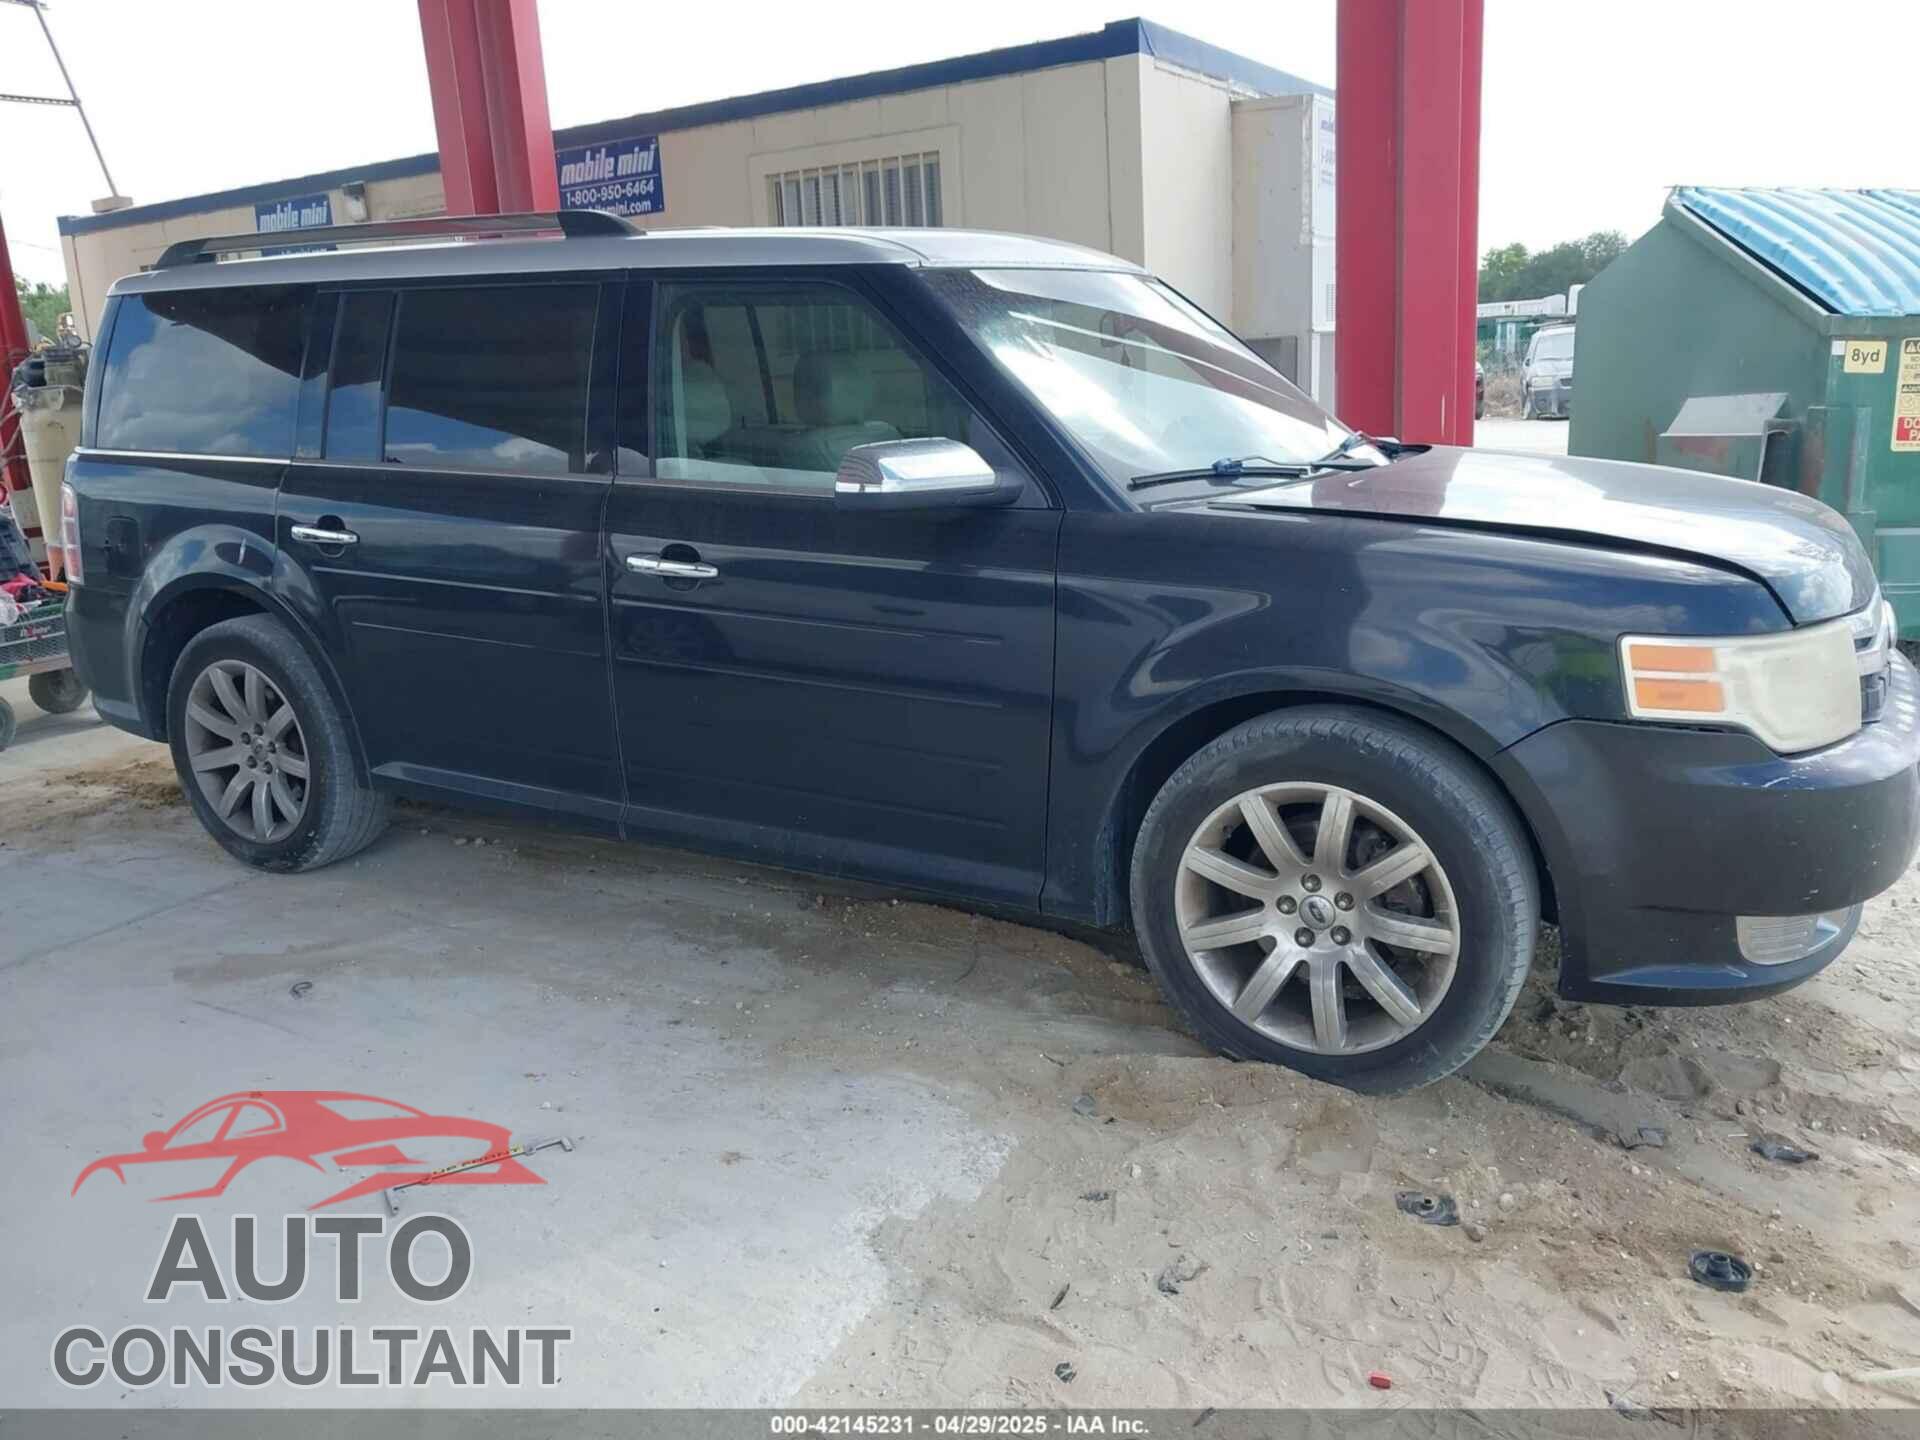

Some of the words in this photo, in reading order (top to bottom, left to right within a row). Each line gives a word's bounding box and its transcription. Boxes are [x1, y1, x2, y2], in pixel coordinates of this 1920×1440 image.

[560, 149, 615, 187] mobile
[616, 143, 657, 177] mini
[565, 179, 655, 207] 1-800-950-6464
[260, 202, 299, 232] mobile
[300, 201, 328, 228] mini
[1851, 348, 1880, 366] 8yd
